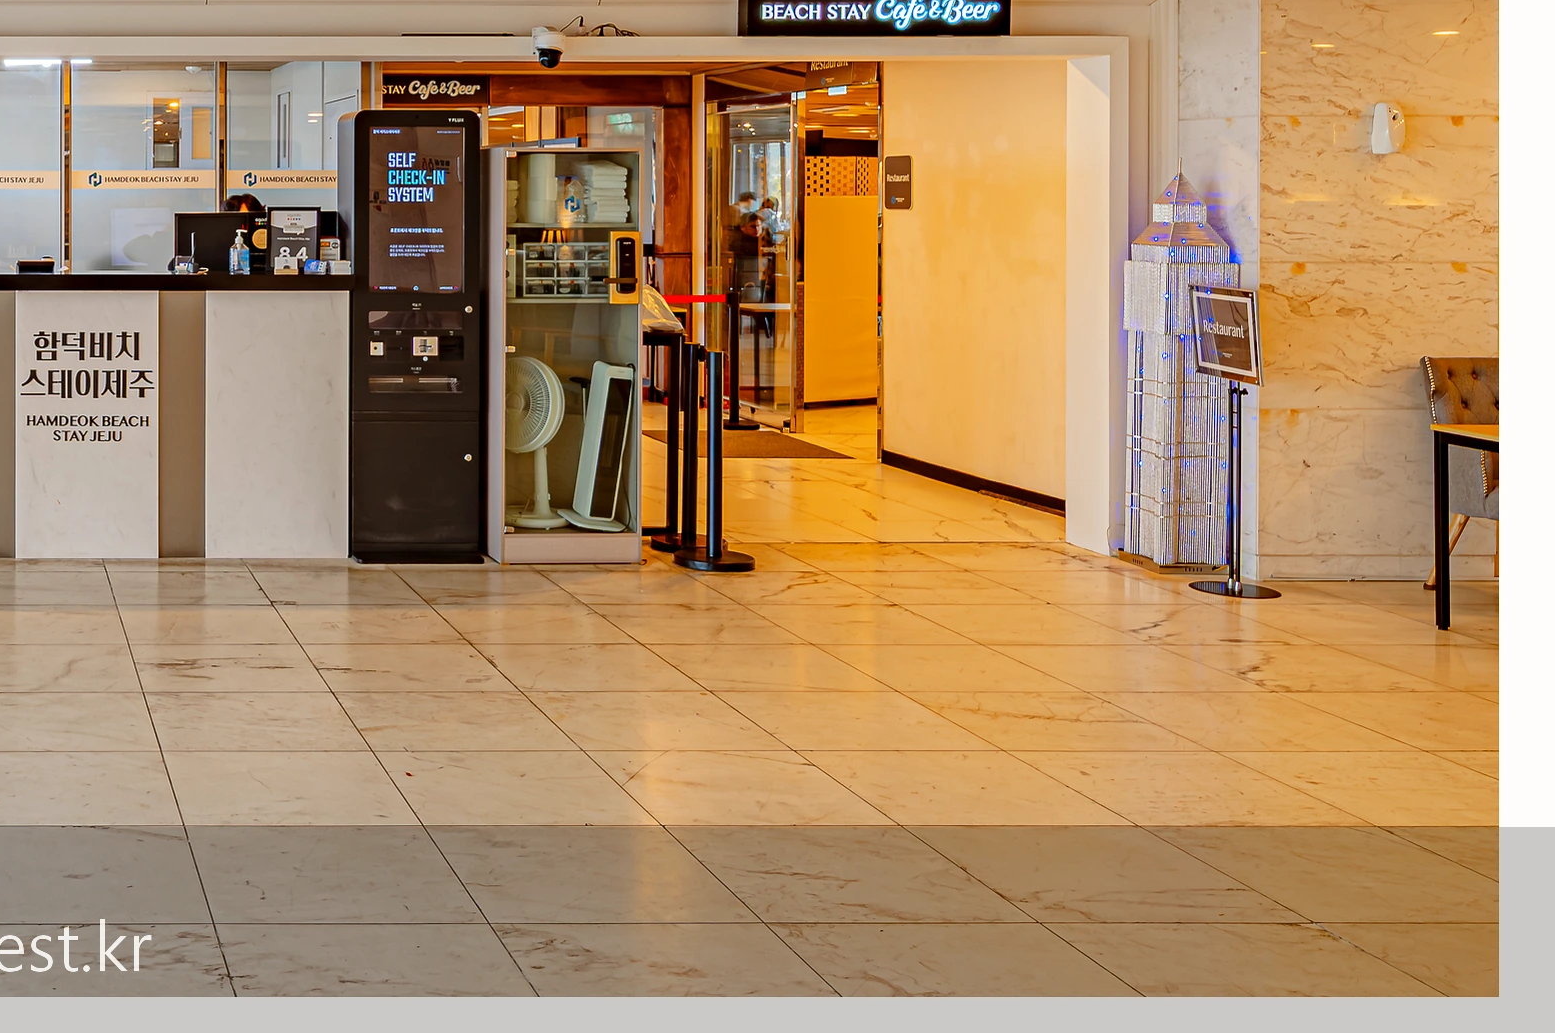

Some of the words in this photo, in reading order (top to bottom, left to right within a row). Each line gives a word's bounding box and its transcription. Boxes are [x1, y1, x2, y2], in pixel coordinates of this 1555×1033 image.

[761, 4, 821, 21] BEACH
[827, 4, 872, 21] STAY
[382, 85, 406, 95] STAY
[387, 152, 417, 168] SELF
[10, 176, 27, 184] STAY
[28, 176, 44, 184] JEJU
[104, 175, 140, 183] HAMDEOK
[140, 175, 164, 183] BEACH
[165, 175, 182, 183] STAY
[183, 175, 199, 183] JEJU
[259, 175, 295, 183] HAMDEOK
[295, 175, 319, 183] BEACH
[320, 175, 337, 183] STAY
[387, 169, 446, 185] CHECK-IN
[886, 173, 910, 183] Restaurant
[387, 186, 435, 203] SYSTEM
[1203, 319, 1245, 339] Restaurant
[33, 331, 140, 362] 함덕비치
[20, 369, 155, 399] 스테이제주
[26, 415, 100, 427] HAMDEOK
[101, 415, 150, 427] BEACH
[53, 429, 87, 442] STAY
[89, 429, 123, 442] JEJU
